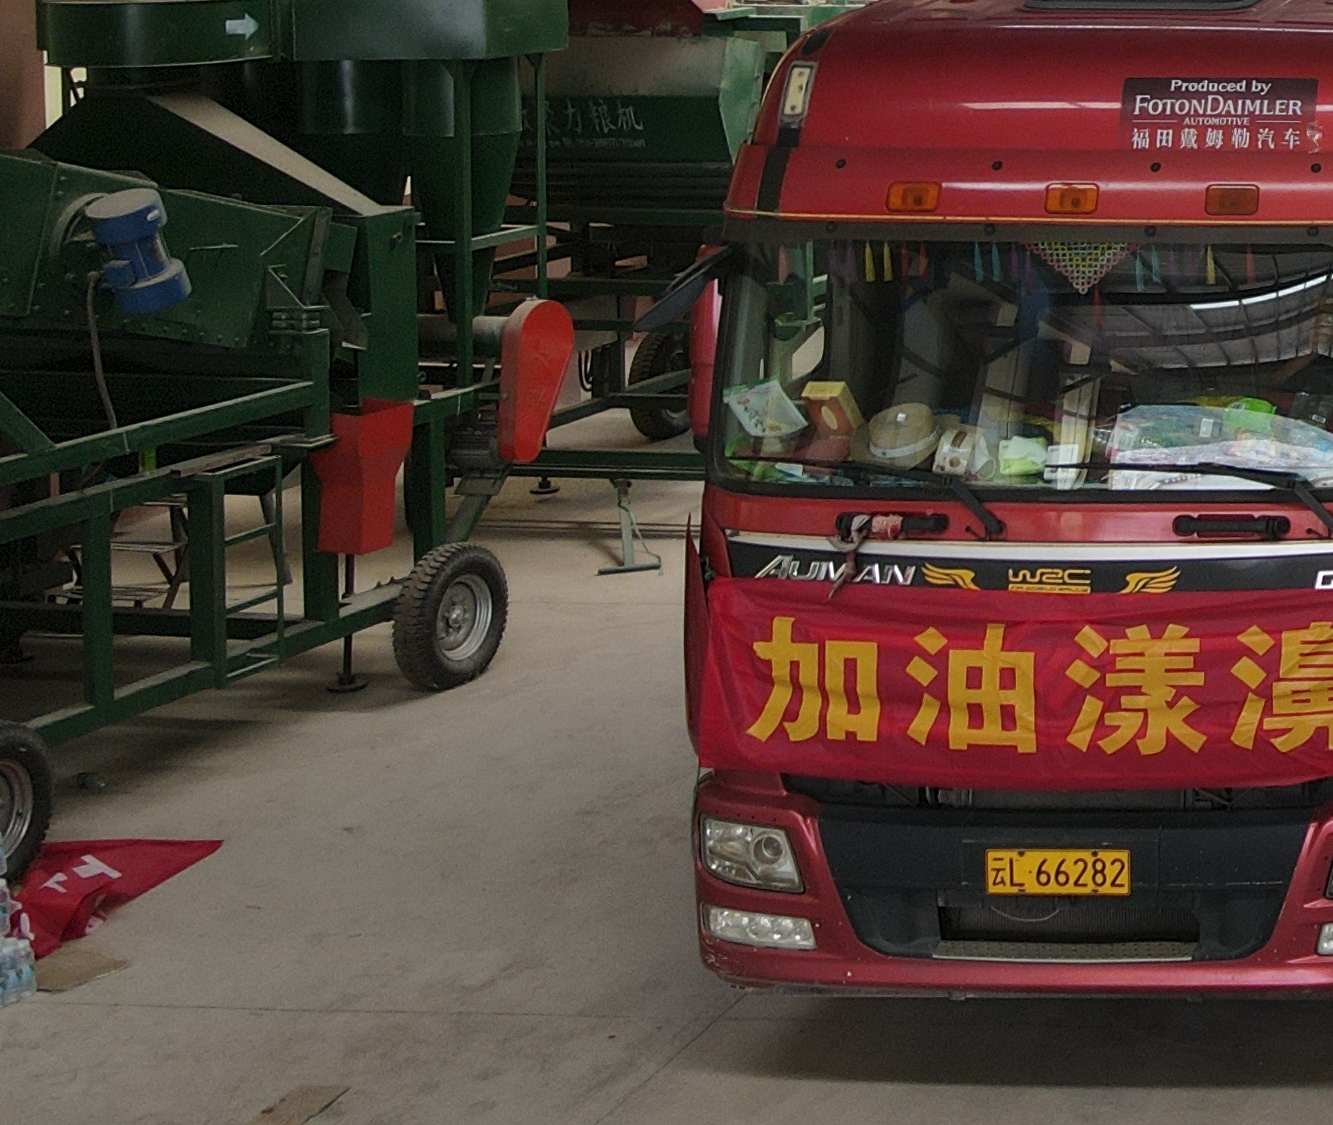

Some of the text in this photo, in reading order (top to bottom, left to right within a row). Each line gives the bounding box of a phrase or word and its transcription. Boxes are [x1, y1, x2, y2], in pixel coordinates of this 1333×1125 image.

[1170, 79, 1272, 95] Produced by
[1132, 94, 1302, 116] FOTONDAIMLER
[1183, 117, 1250, 126] AUTOMOTIVE
[1131, 127, 1301, 150] 福田戴姆勒汽车
[755, 555, 916, 585] AUMAN
[1008, 568, 1091, 584] WRC
